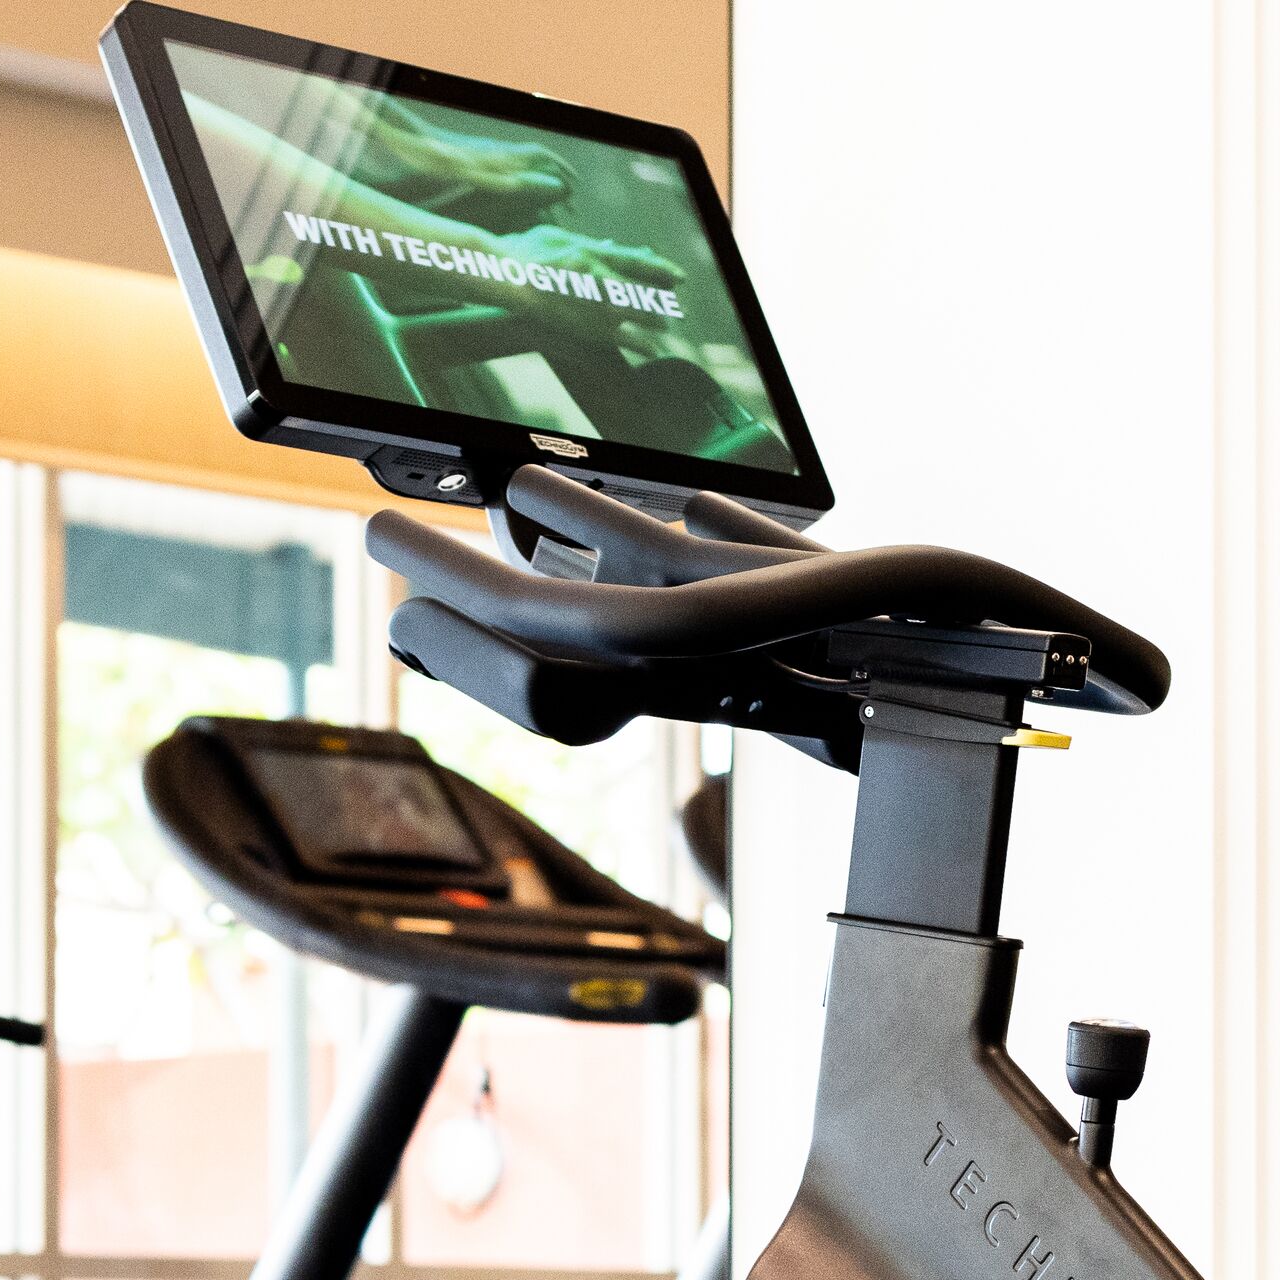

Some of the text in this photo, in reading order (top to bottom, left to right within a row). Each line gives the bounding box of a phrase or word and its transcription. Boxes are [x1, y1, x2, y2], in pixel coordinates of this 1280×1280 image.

[283, 211, 685, 318] WITH TECHNOGYM BIKE
